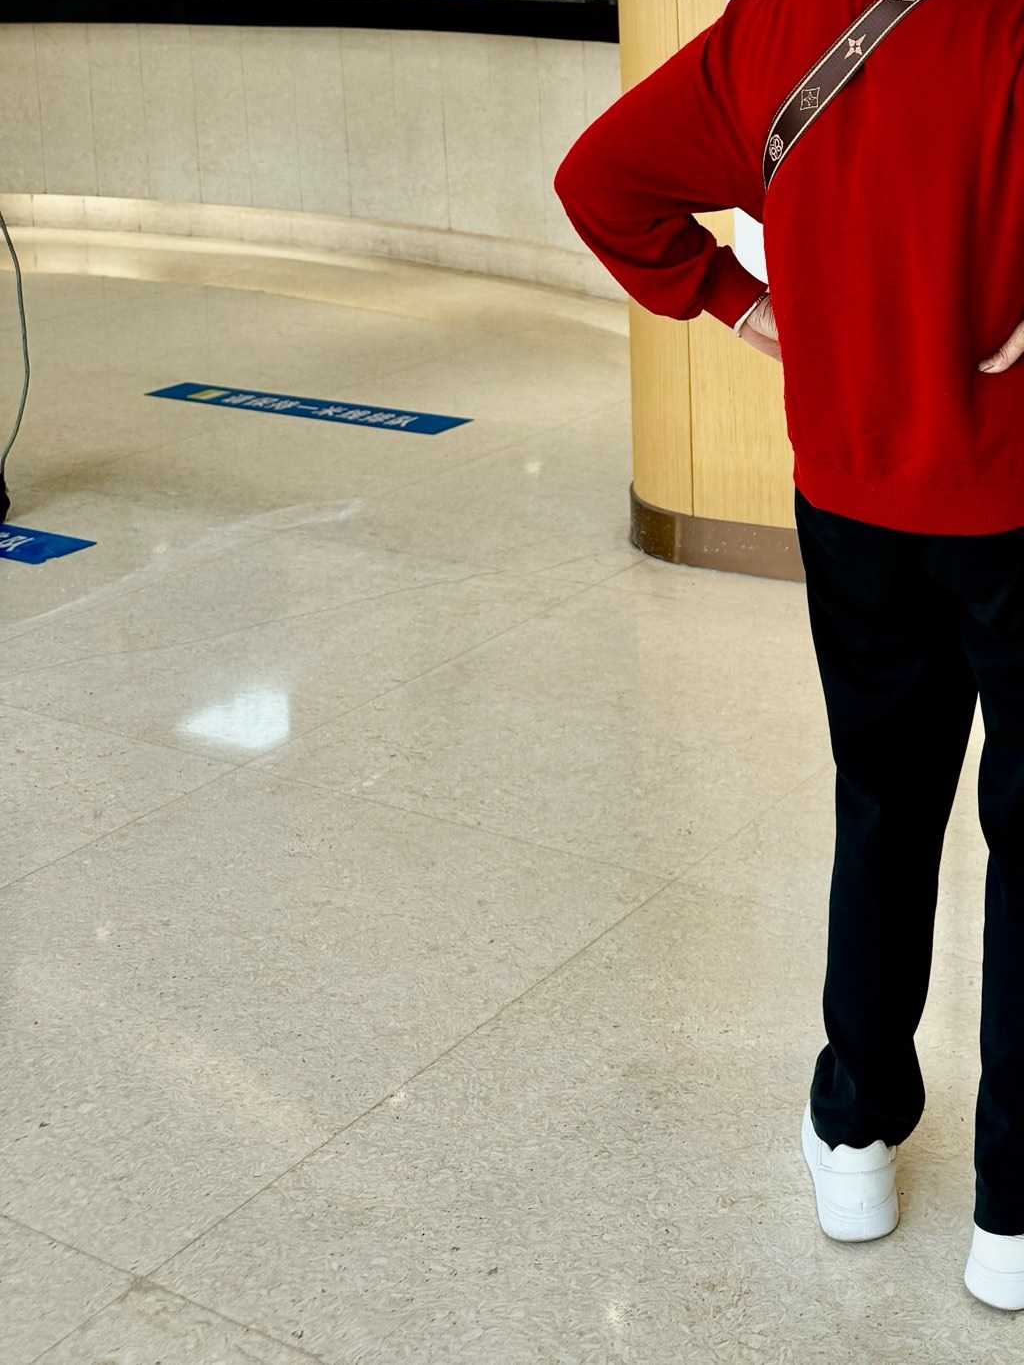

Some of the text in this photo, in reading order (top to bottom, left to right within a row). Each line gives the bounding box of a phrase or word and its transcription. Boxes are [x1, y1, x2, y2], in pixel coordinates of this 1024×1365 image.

[221, 393, 419, 427] 请保持一米线排队
